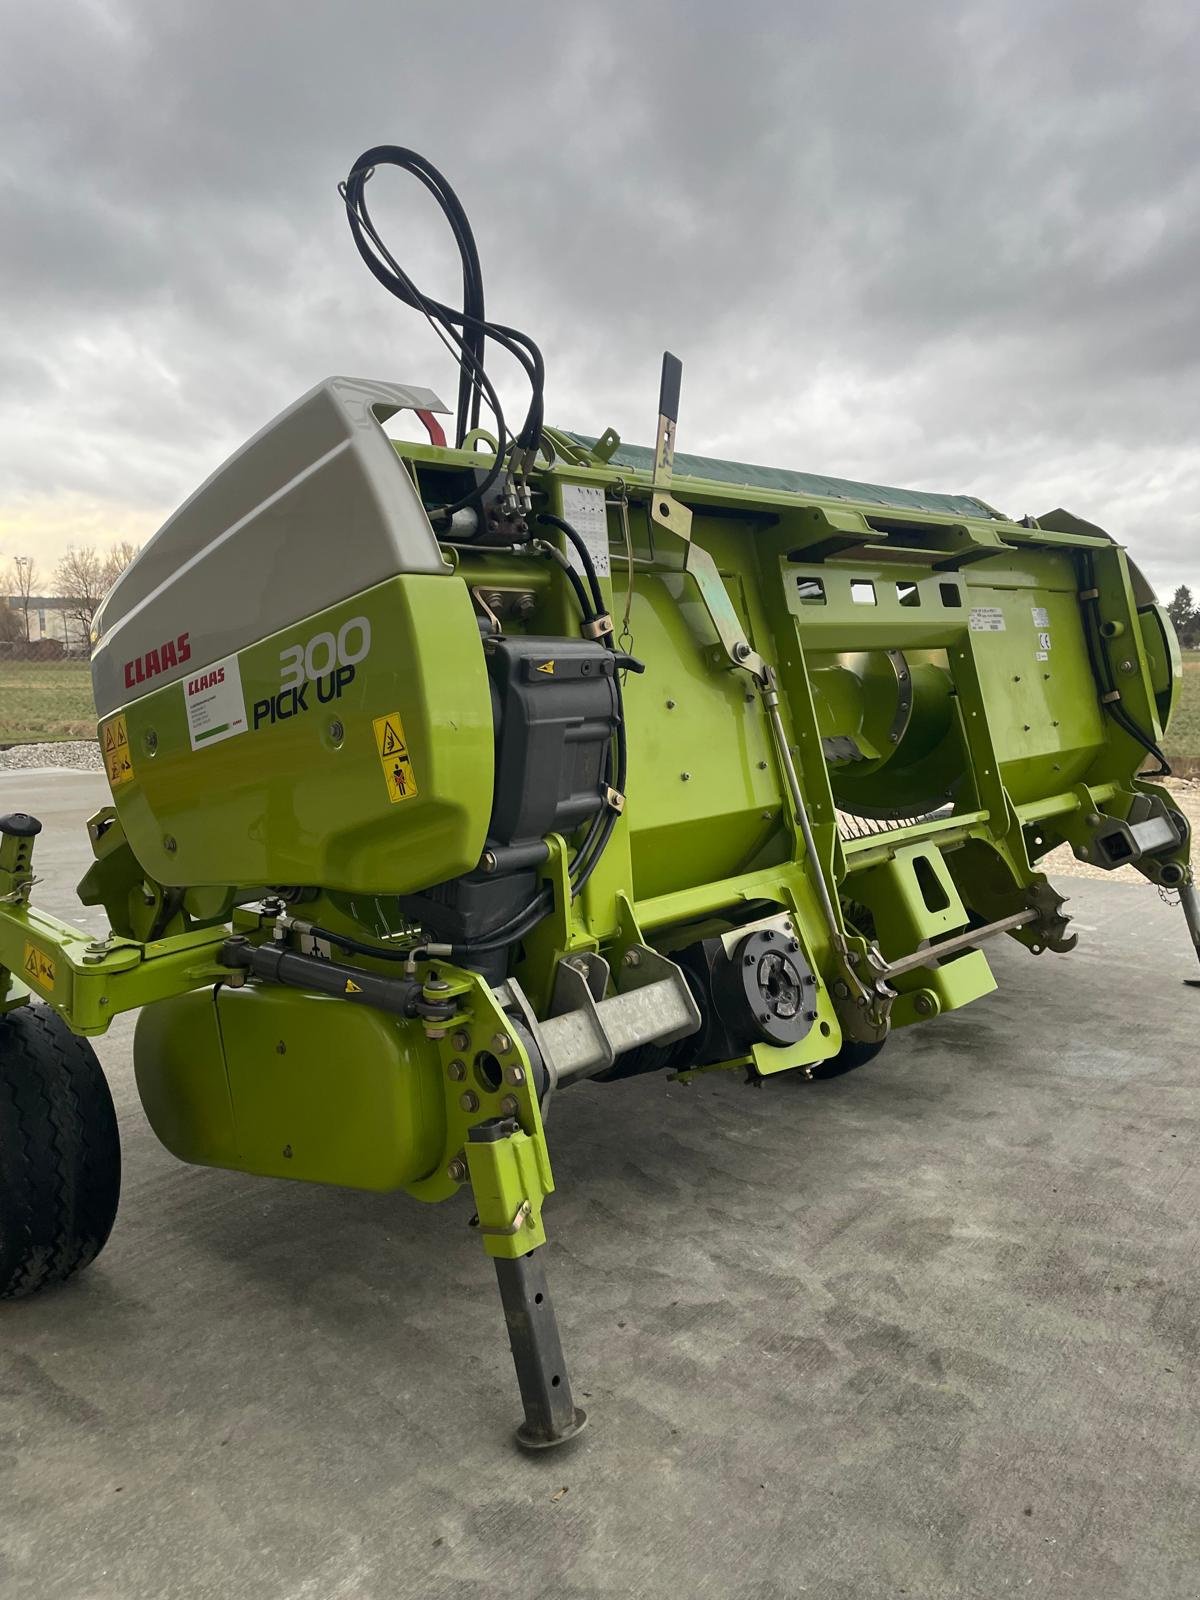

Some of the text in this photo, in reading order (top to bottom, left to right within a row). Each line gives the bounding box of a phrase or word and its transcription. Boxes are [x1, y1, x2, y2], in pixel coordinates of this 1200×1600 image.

[124, 632, 191, 689] CLAAS
[188, 667, 225, 696] CLAAS
[279, 616, 371, 693] 300
[253, 664, 355, 730] PICK UP
